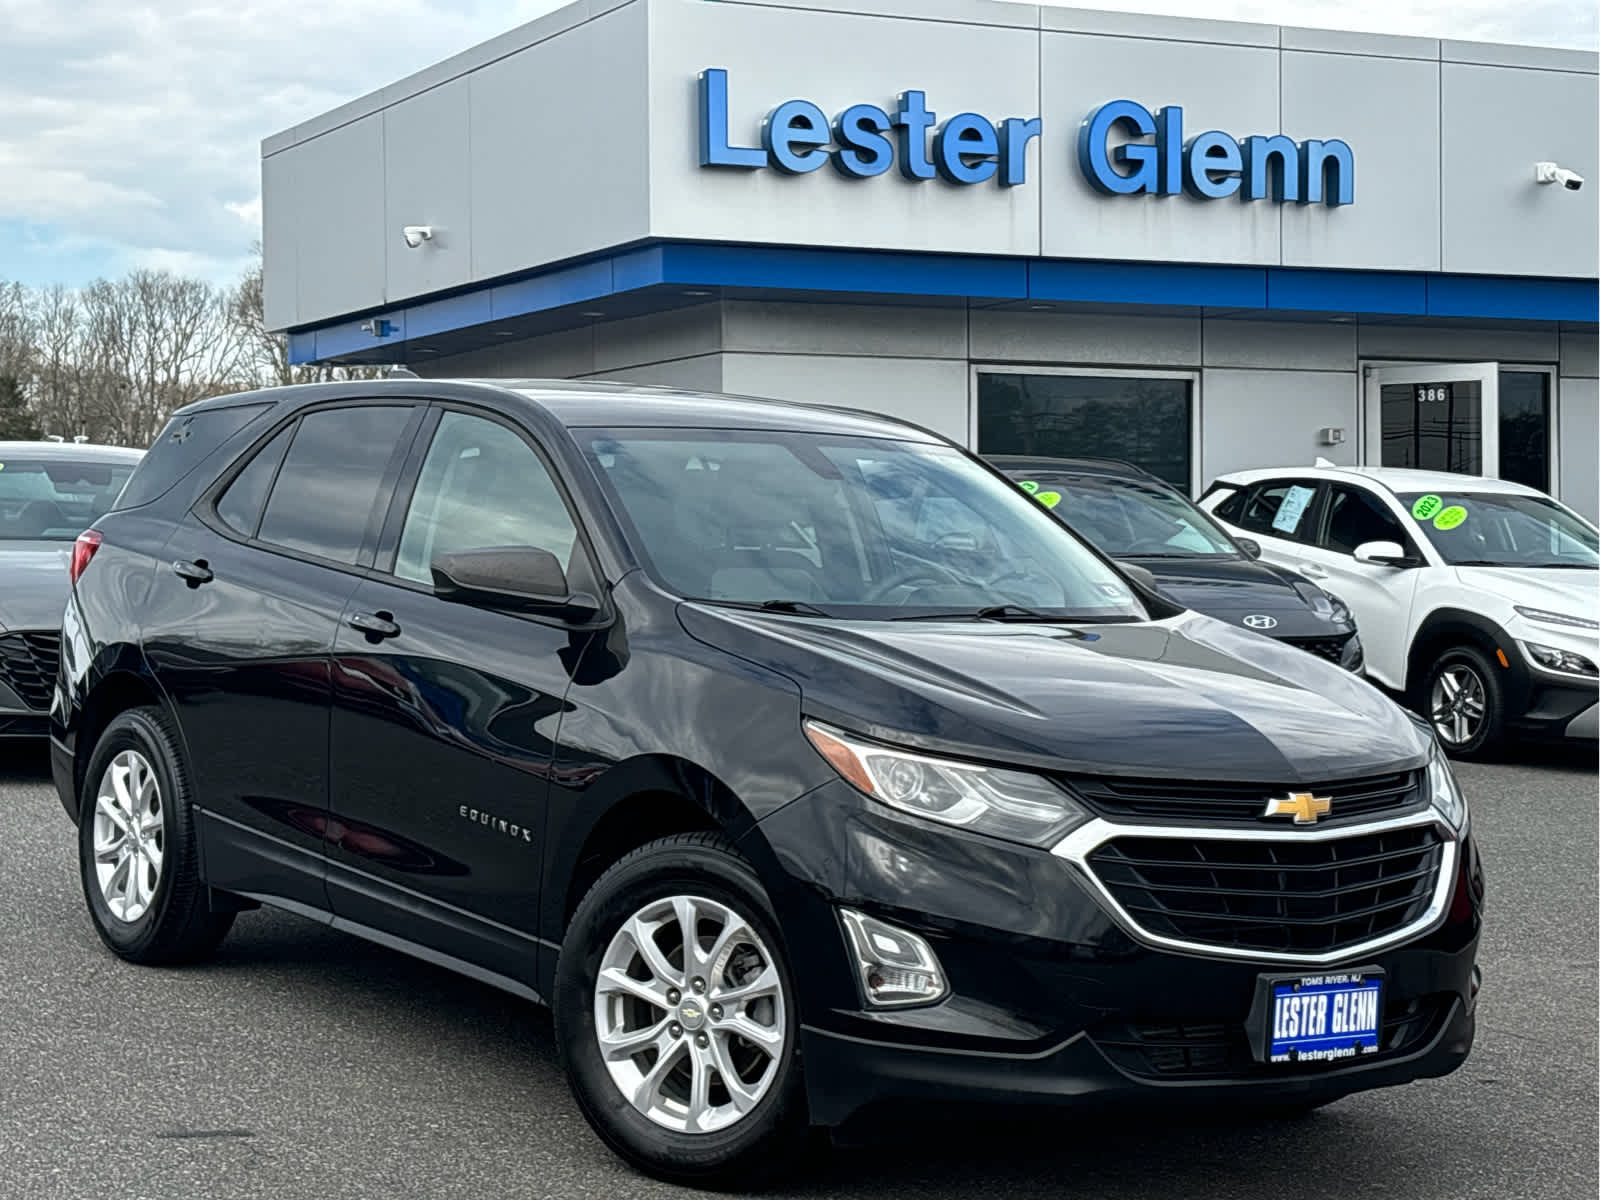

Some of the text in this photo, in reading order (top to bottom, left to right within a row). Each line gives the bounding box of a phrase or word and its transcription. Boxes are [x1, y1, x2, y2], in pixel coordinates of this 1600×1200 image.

[699, 69, 1356, 206] Lester Glenn
[1418, 388, 1445, 402] 386
[1416, 496, 1439, 517] 2023
[459, 805, 532, 842] EQUINOX
[1301, 977, 1323, 986] TOMS
[1351, 974, 1361, 983] NJ
[1275, 991, 1378, 1039] LESTER GLENN
